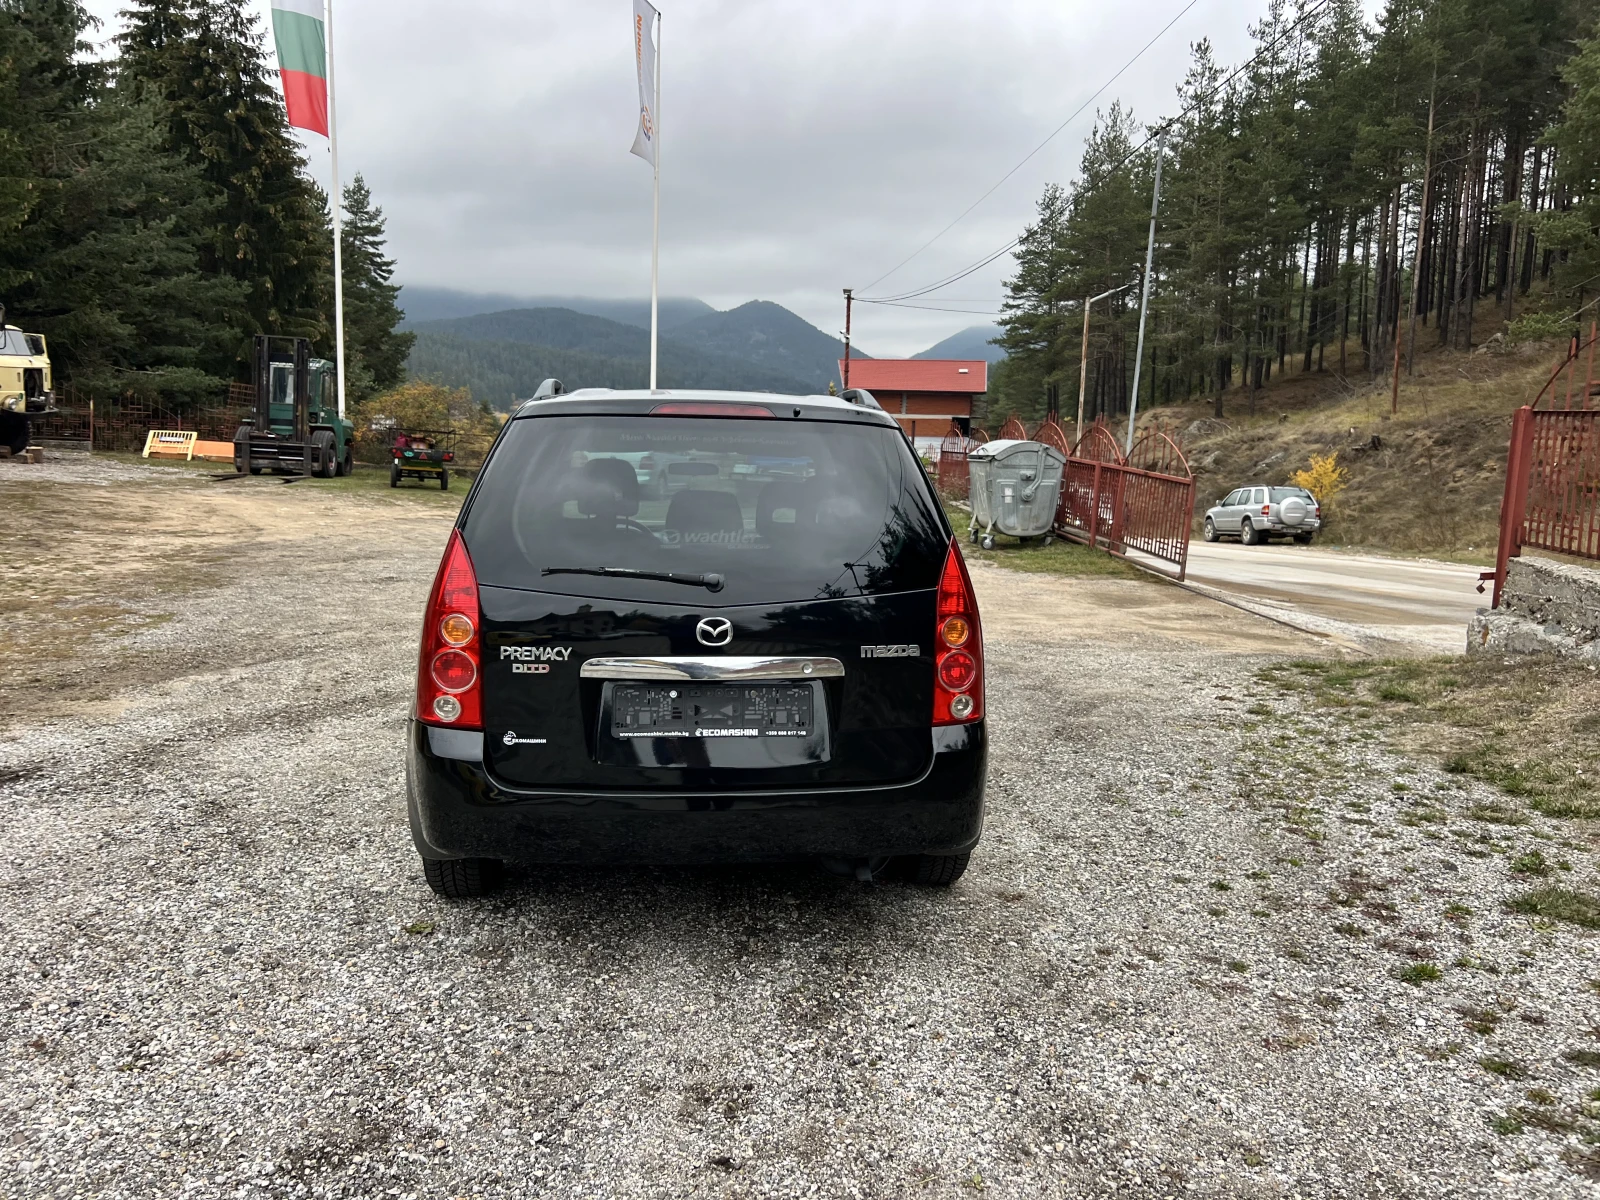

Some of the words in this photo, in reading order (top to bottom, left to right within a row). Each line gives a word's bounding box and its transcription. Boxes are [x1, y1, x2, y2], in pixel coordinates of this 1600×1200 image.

[684, 529, 758, 543] wachtler
[500, 645, 573, 661] PREMACY
[702, 728, 759, 736] ECOMASHINI
